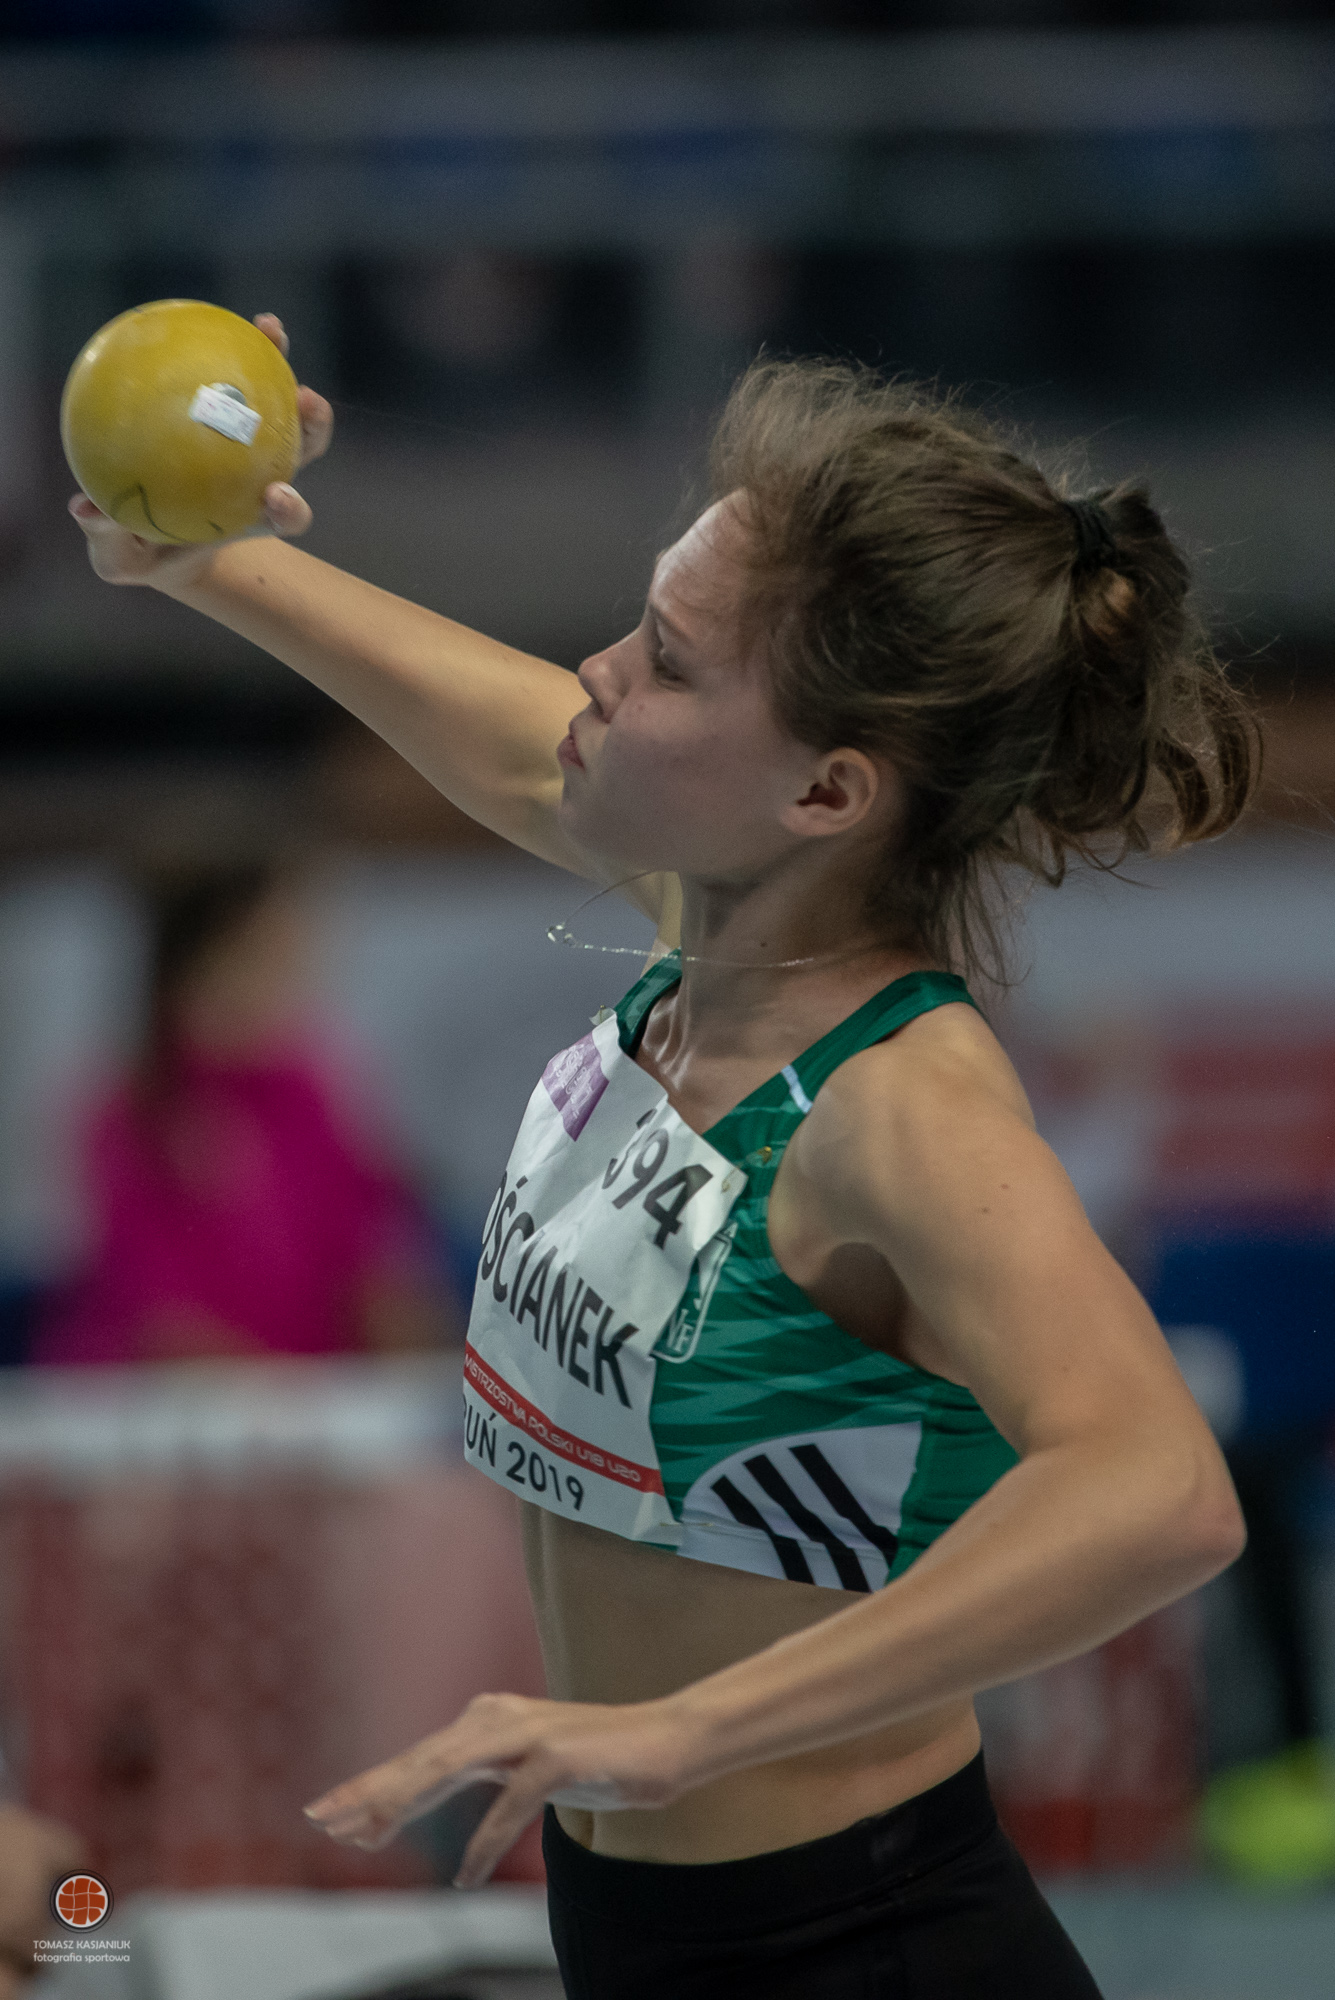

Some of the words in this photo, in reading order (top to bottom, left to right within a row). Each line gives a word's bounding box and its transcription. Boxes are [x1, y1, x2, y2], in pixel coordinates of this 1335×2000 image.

[463, 1394, 497, 1468] UŃ
[506, 1441, 584, 1511] 2019
[528, 1416, 574, 1454] POLSKI
[576, 1446, 605, 1467] U18
[607, 1459, 641, 1482] U20
